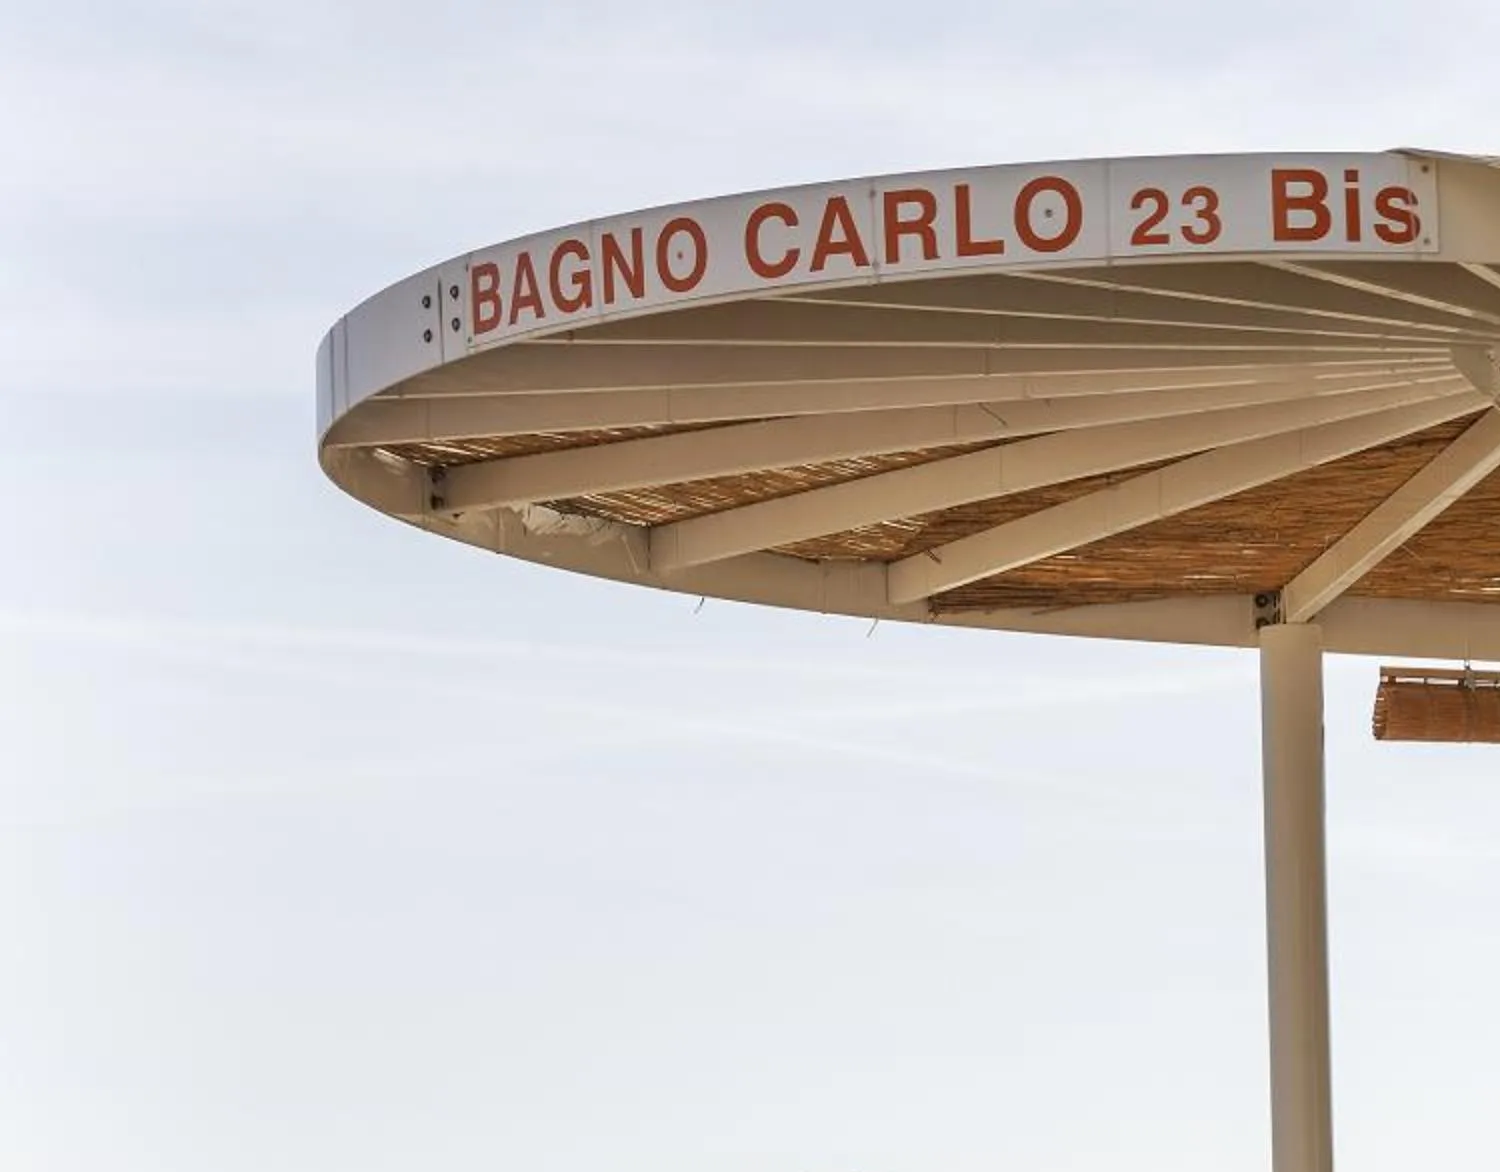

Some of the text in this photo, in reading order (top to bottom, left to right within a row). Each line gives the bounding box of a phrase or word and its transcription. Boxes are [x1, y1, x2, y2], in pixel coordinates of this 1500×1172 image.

[470, 168, 1422, 336] BAGNO CARLO 23 Bis
